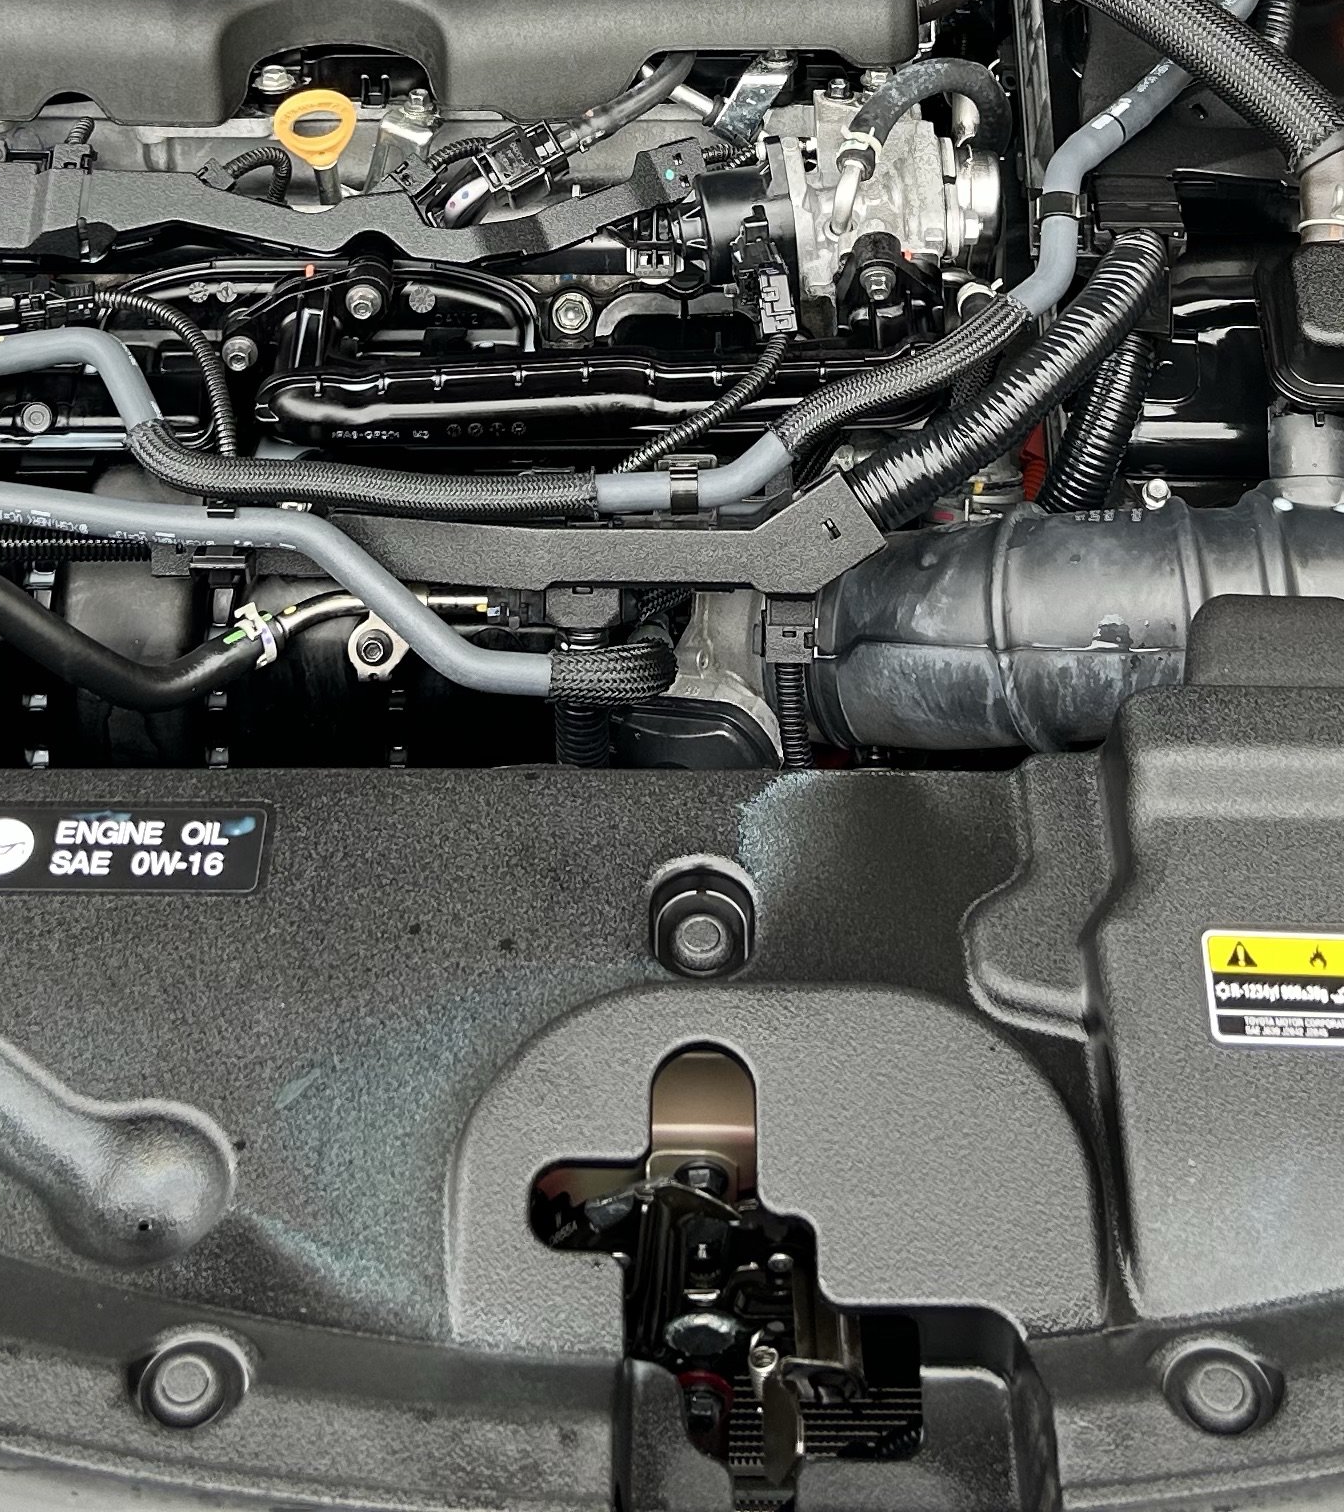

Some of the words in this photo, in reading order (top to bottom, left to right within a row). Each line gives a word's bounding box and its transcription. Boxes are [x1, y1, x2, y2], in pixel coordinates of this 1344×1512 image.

[55, 820, 165, 846] ENGINE
[181, 820, 230, 846] OIL
[49, 850, 112, 875] SAE
[131, 850, 225, 876] 0W-16
[1244, 1015, 1275, 1026] TOYOTA
[1275, 1016, 1304, 1027] MOTOR
